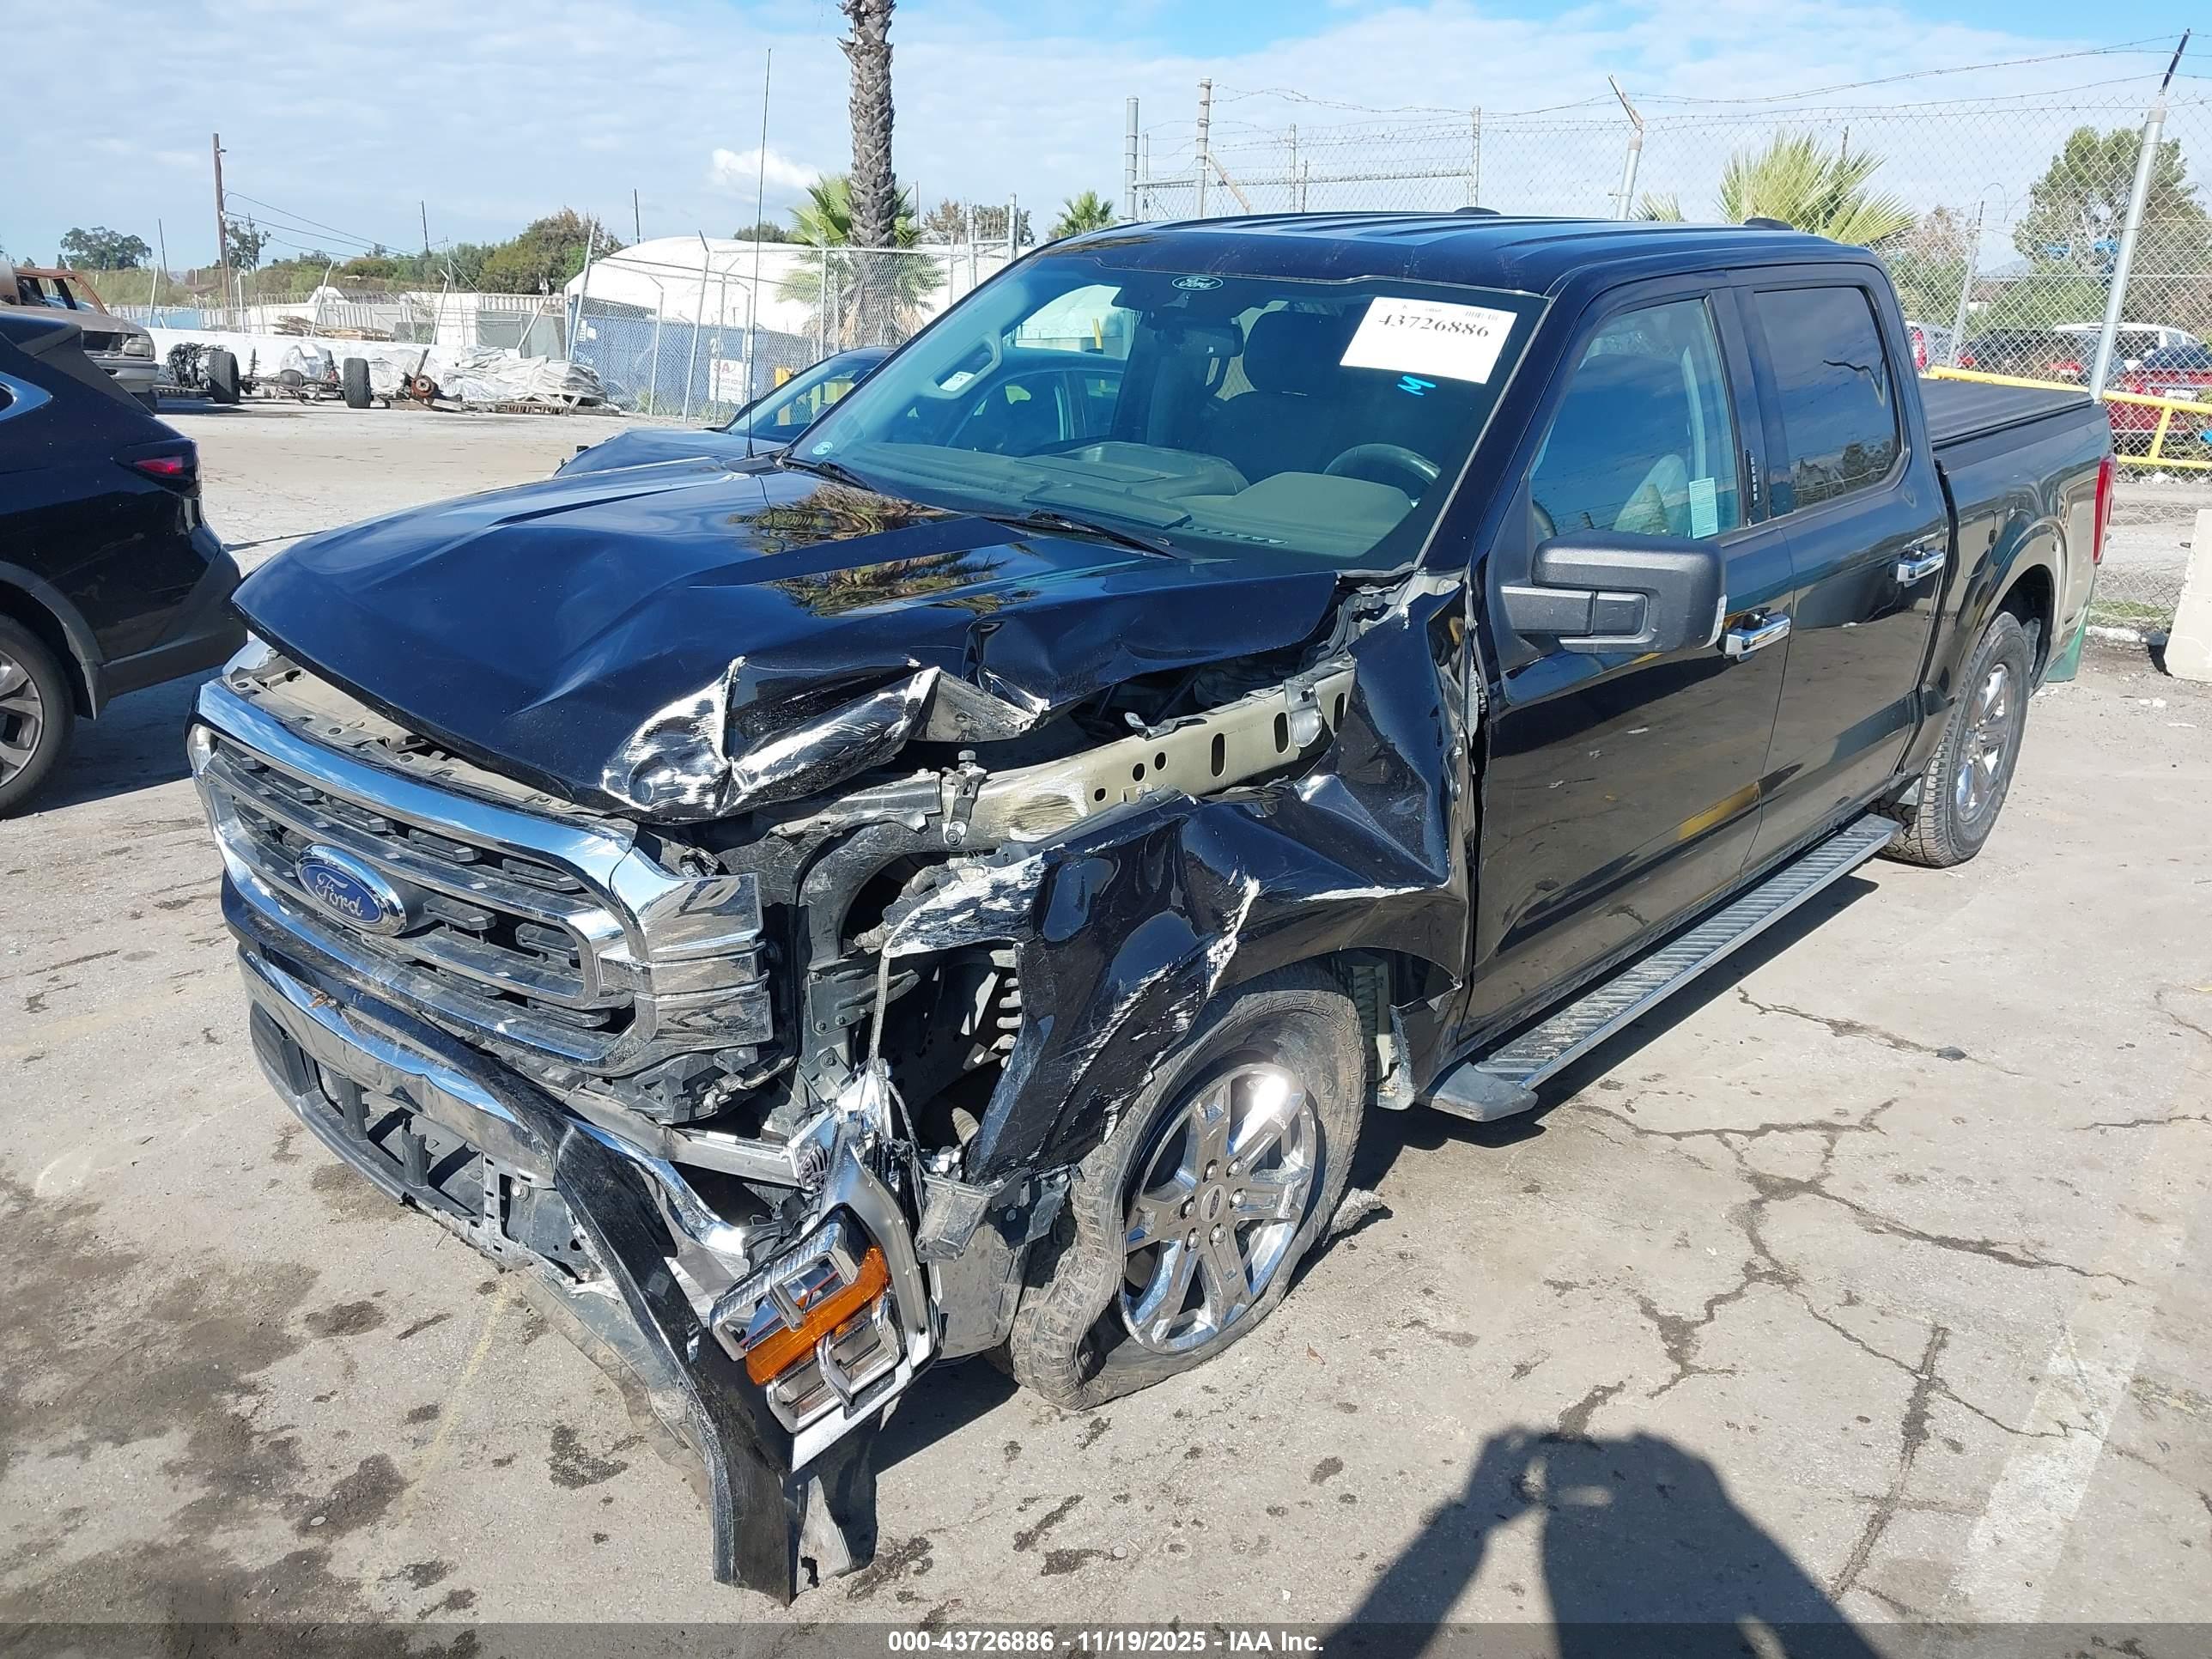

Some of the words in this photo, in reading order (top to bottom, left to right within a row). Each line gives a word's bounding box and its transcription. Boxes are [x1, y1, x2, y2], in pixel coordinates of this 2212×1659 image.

[1178, 276, 1217, 289] Ford
[1378, 313, 1490, 338] 43726886
[314, 872, 364, 917] Ford
